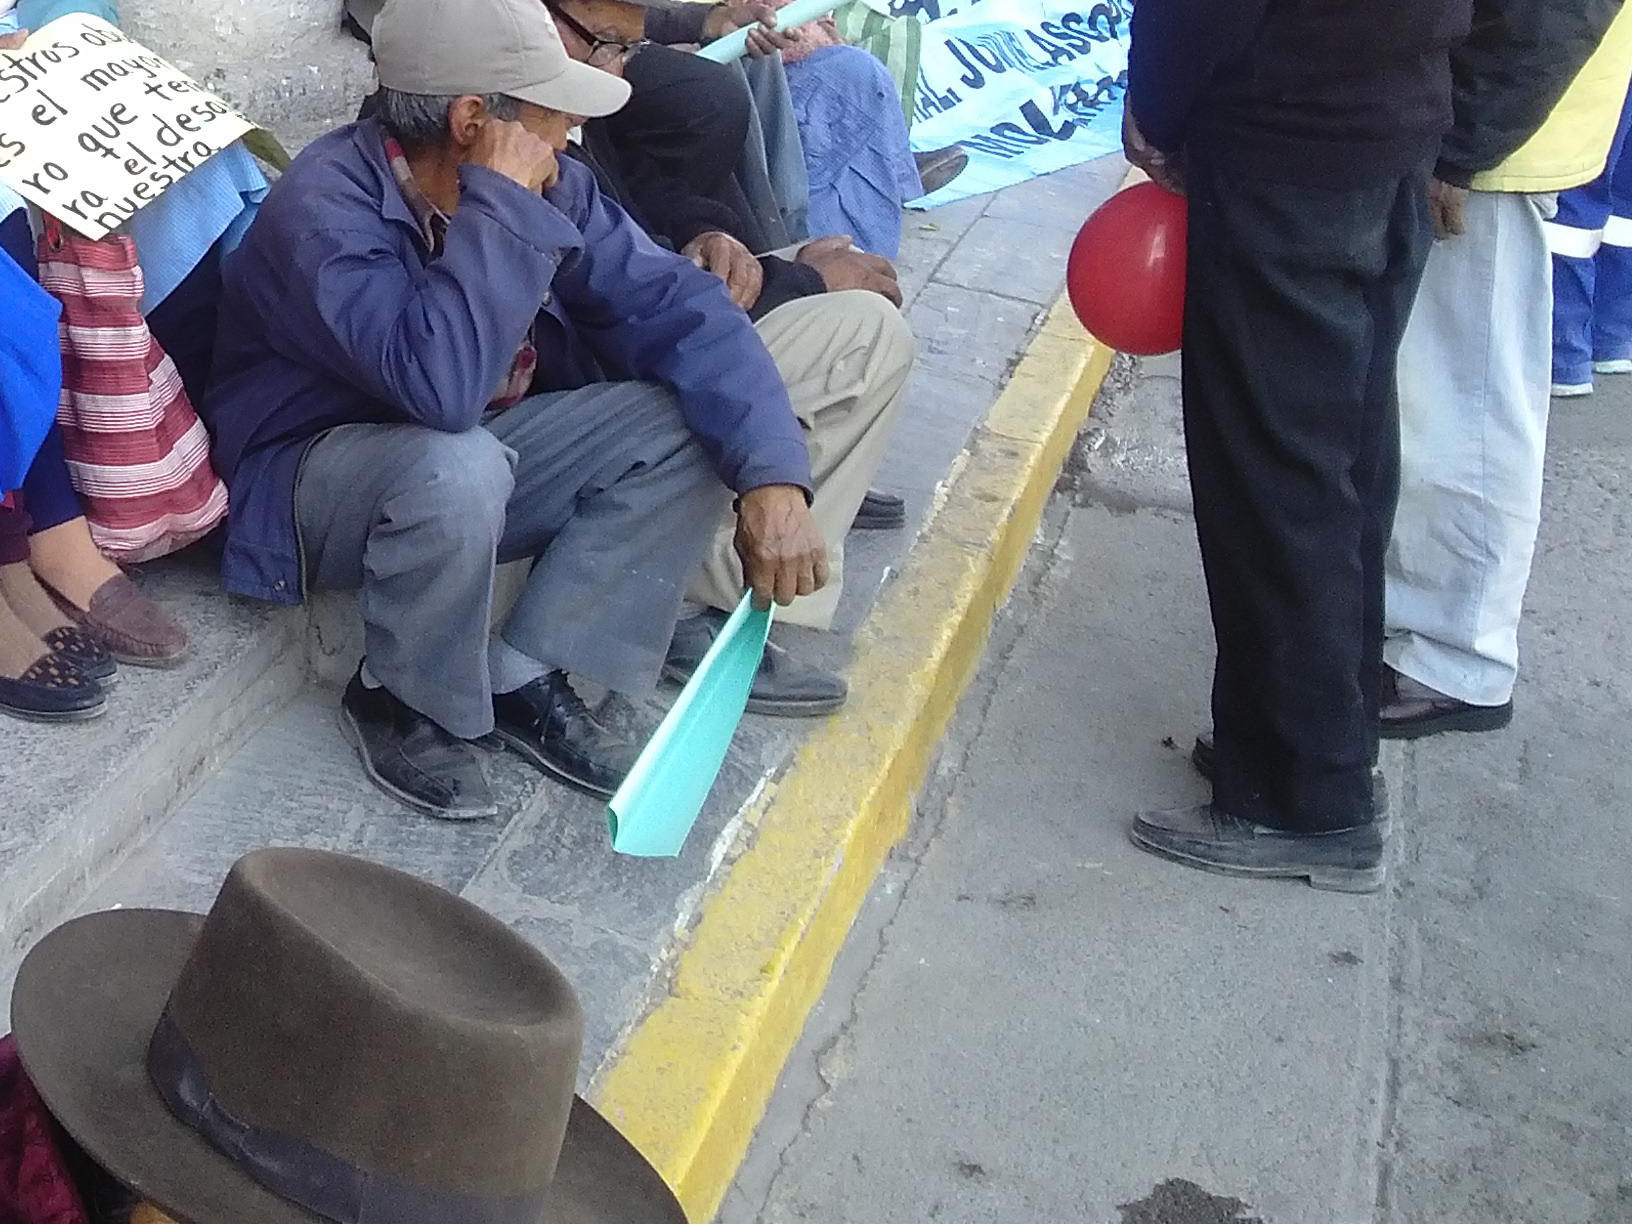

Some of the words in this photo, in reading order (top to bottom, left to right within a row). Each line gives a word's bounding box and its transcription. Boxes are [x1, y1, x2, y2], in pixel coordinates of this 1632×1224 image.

[31, 88, 68, 126] el
[21, 161, 69, 195] ro
[77, 102, 139, 160] que
[61, 190, 110, 221] ra
[123, 140, 157, 176] el
